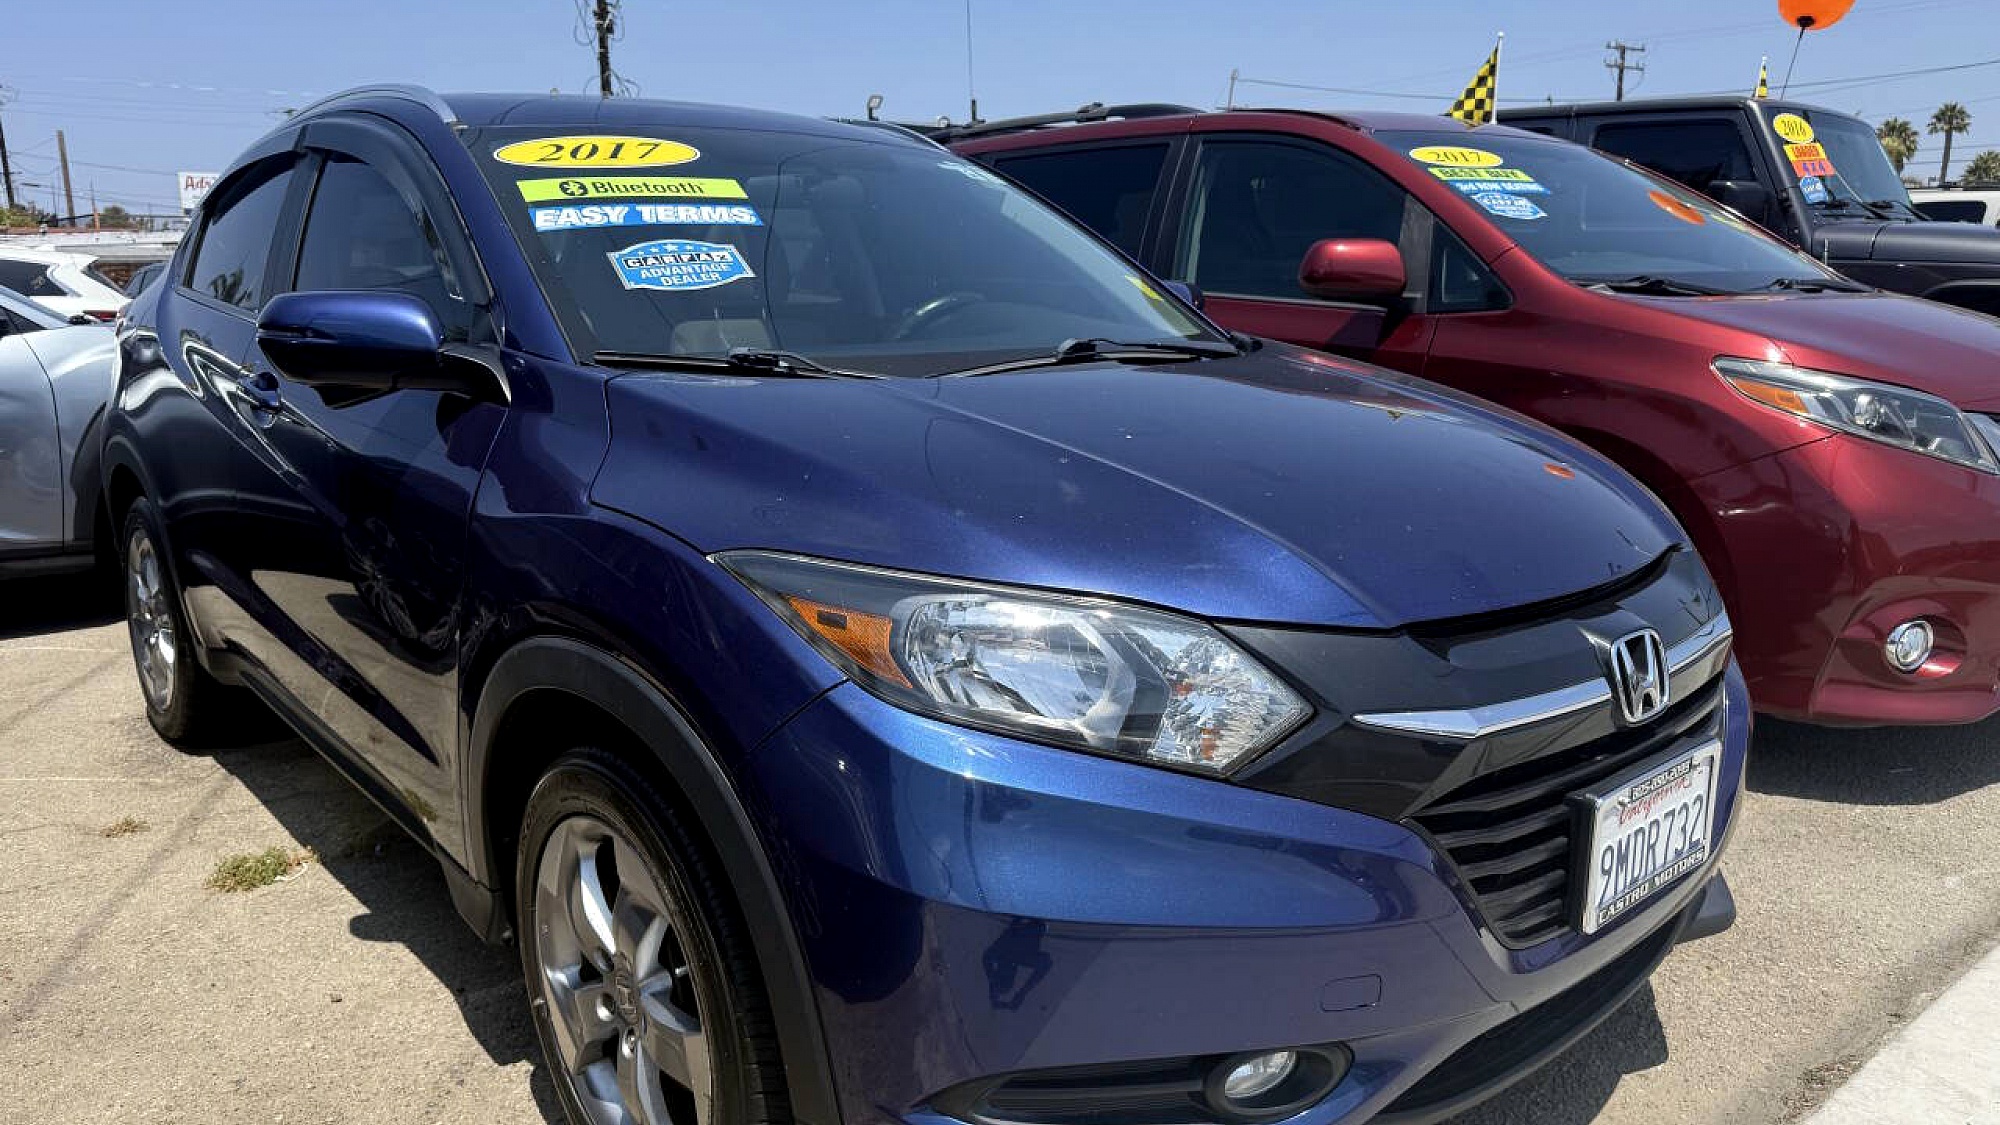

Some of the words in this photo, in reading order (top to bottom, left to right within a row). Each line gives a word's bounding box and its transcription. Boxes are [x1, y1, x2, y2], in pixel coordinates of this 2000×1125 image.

[537, 142, 662, 162] 2017
[1427, 151, 1481, 162] 2017
[591, 180, 704, 195] Bluetooth
[535, 205, 627, 227] EASY
[639, 205, 757, 224] TERMS
[625, 251, 733, 268] CARFAX
[641, 263, 731, 279] ADVANTAGE
[661, 272, 722, 285] DEALER
[1600, 793, 1704, 903] 9MDR732
[1600, 884, 1648, 922] CASTRO
[1653, 847, 1705, 888] MOTORS
